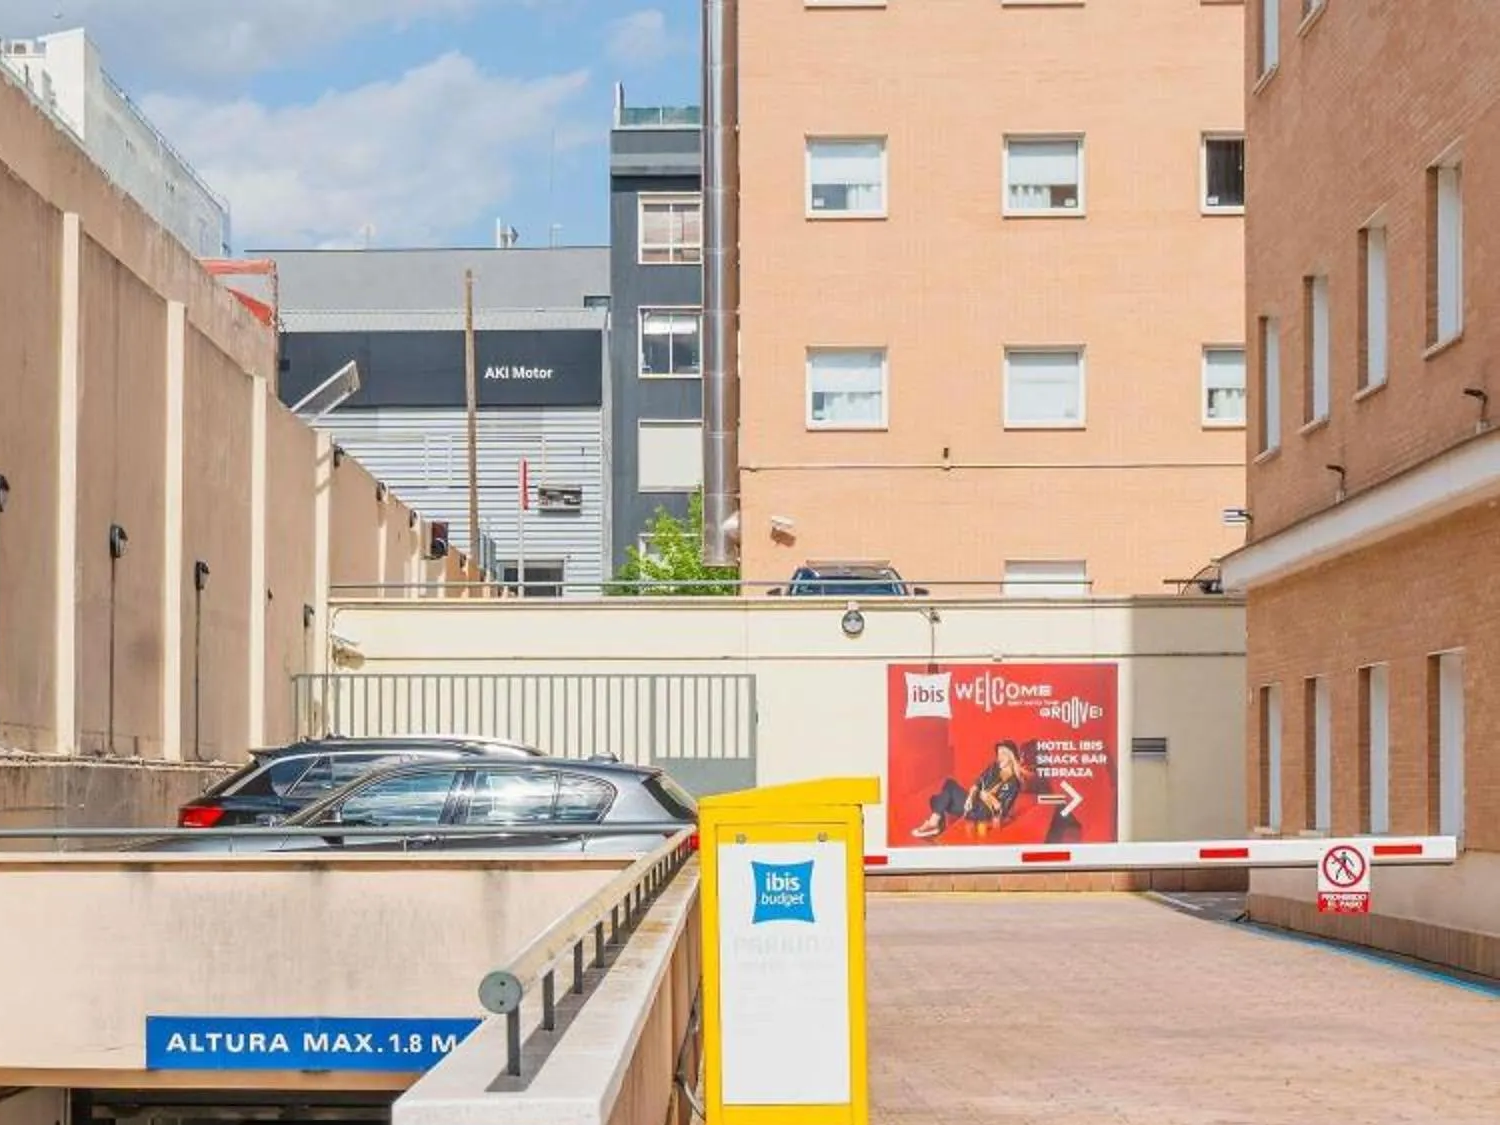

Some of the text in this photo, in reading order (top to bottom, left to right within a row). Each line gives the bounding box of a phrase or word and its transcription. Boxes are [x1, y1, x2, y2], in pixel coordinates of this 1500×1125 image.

[484, 366, 553, 379] AKI Motor
[912, 686, 945, 703] ibis
[954, 671, 1052, 713] WELCOME
[1036, 740, 1103, 751] HOTEL IBIS
[1036, 754, 1107, 765] SNACK BAR
[1036, 767, 1093, 778] TERRAZA
[765, 872, 801, 892] ibis
[761, 892, 805, 907] budget
[166, 1032, 457, 1054] ALTURA MAX. 1.8 M
